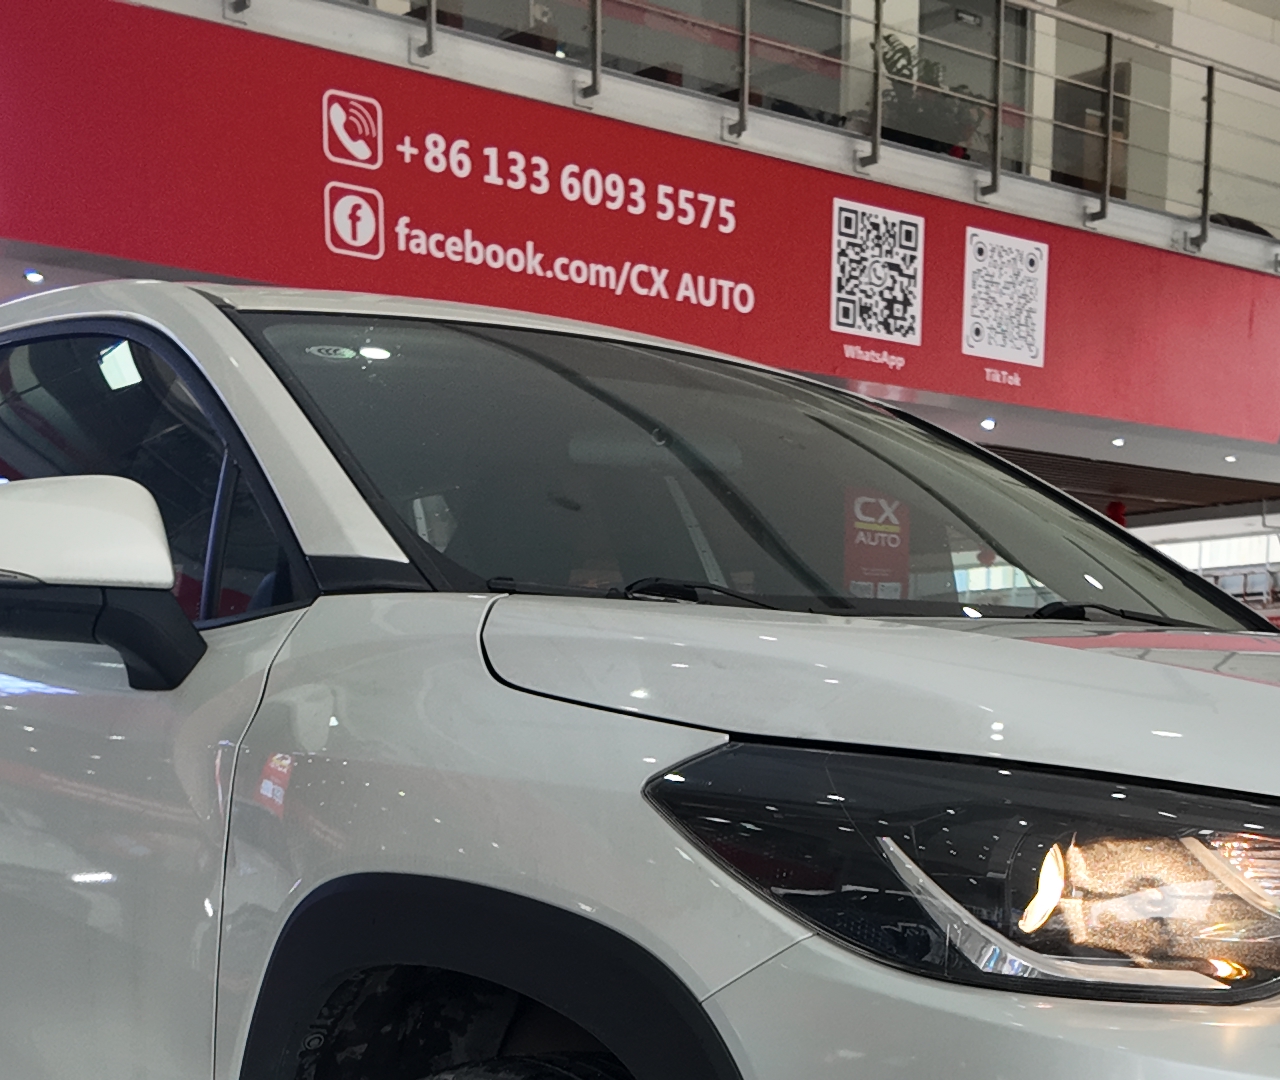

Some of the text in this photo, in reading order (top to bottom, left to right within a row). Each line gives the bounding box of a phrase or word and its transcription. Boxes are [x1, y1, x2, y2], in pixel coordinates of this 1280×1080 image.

[396, 133, 737, 234] +86 133 6093 5575
[395, 216, 755, 314] facebook.com/CX AUTO
[842, 343, 906, 370] WhatsApp
[984, 367, 1022, 387] TikTok
[853, 496, 901, 525] CX
[854, 530, 902, 548] AUTO
